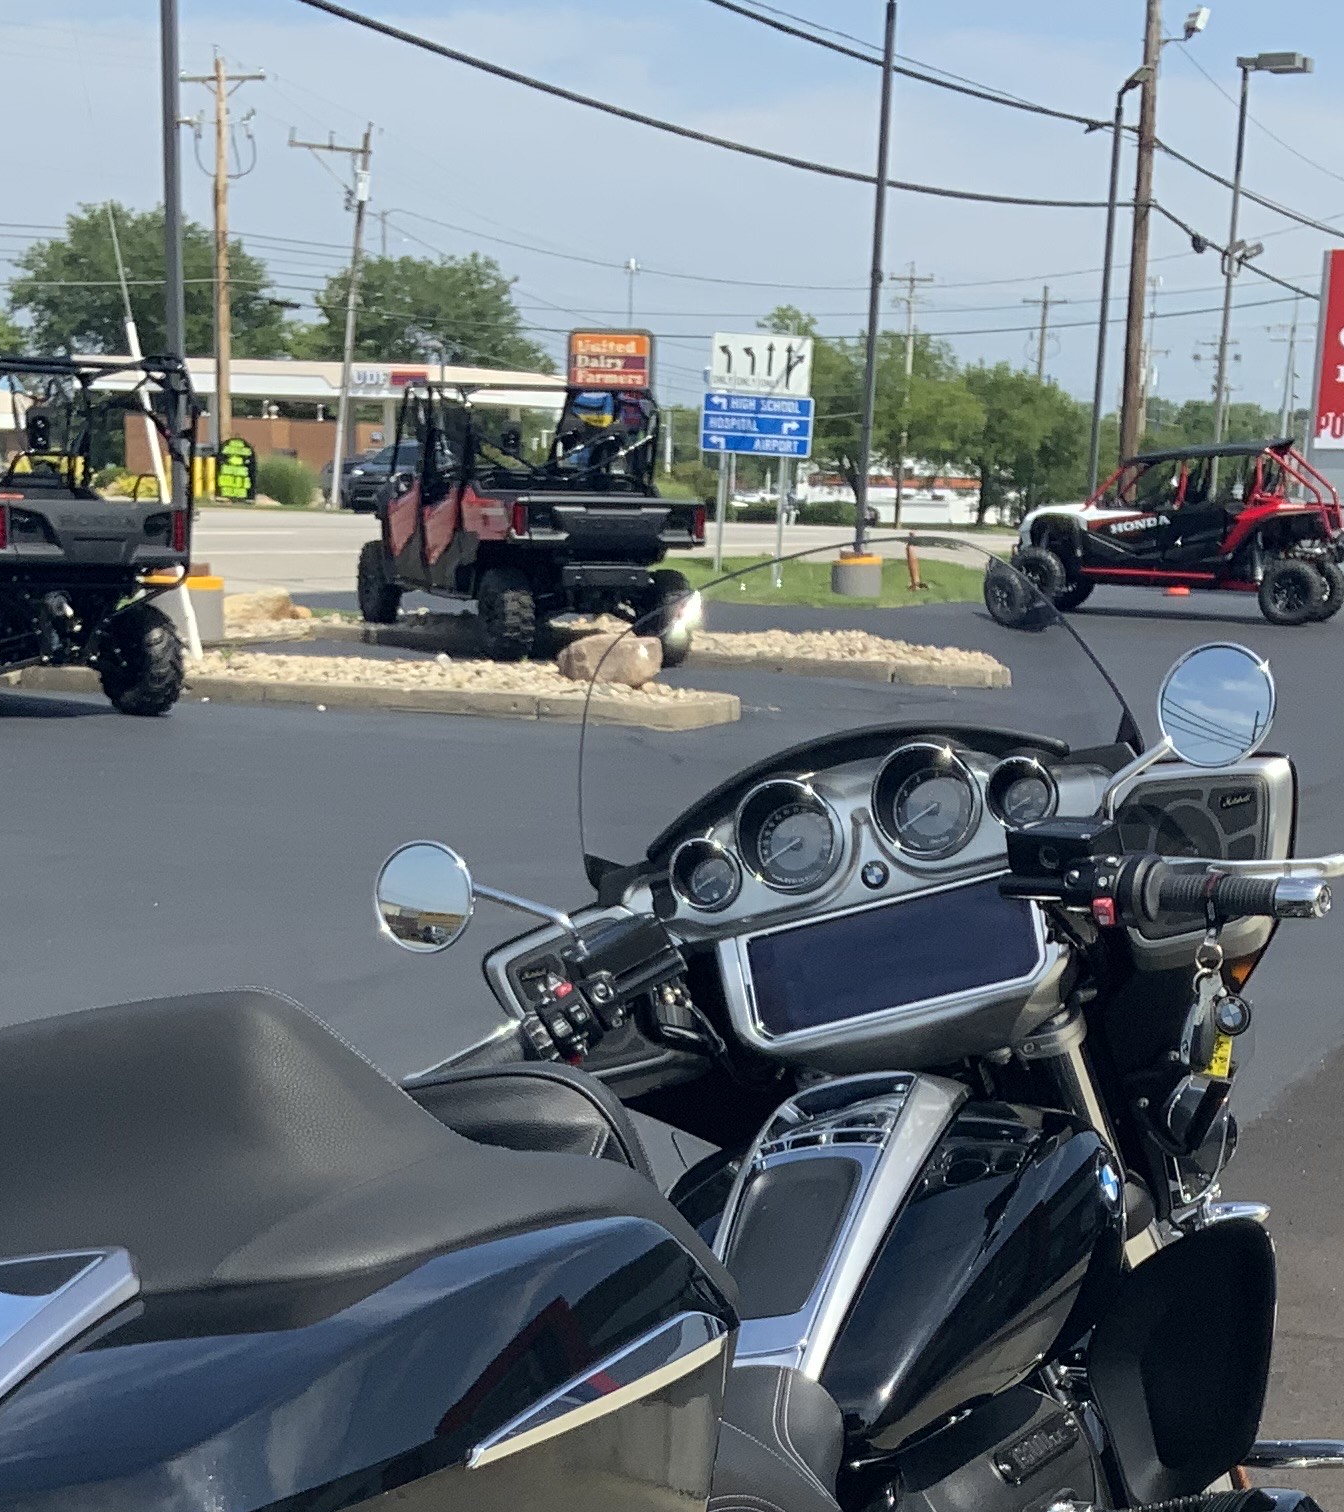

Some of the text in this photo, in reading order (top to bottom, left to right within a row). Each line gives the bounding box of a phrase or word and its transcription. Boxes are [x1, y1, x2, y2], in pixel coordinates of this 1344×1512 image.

[578, 340, 636, 353] United
[577, 355, 626, 369] Dairy
[576, 370, 644, 385] Farmers
[730, 398, 801, 414] HIGH SCHOOL
[708, 416, 758, 431] HOSPITAL
[753, 438, 800, 453] AIRPORT
[1110, 515, 1172, 534] HONDA
